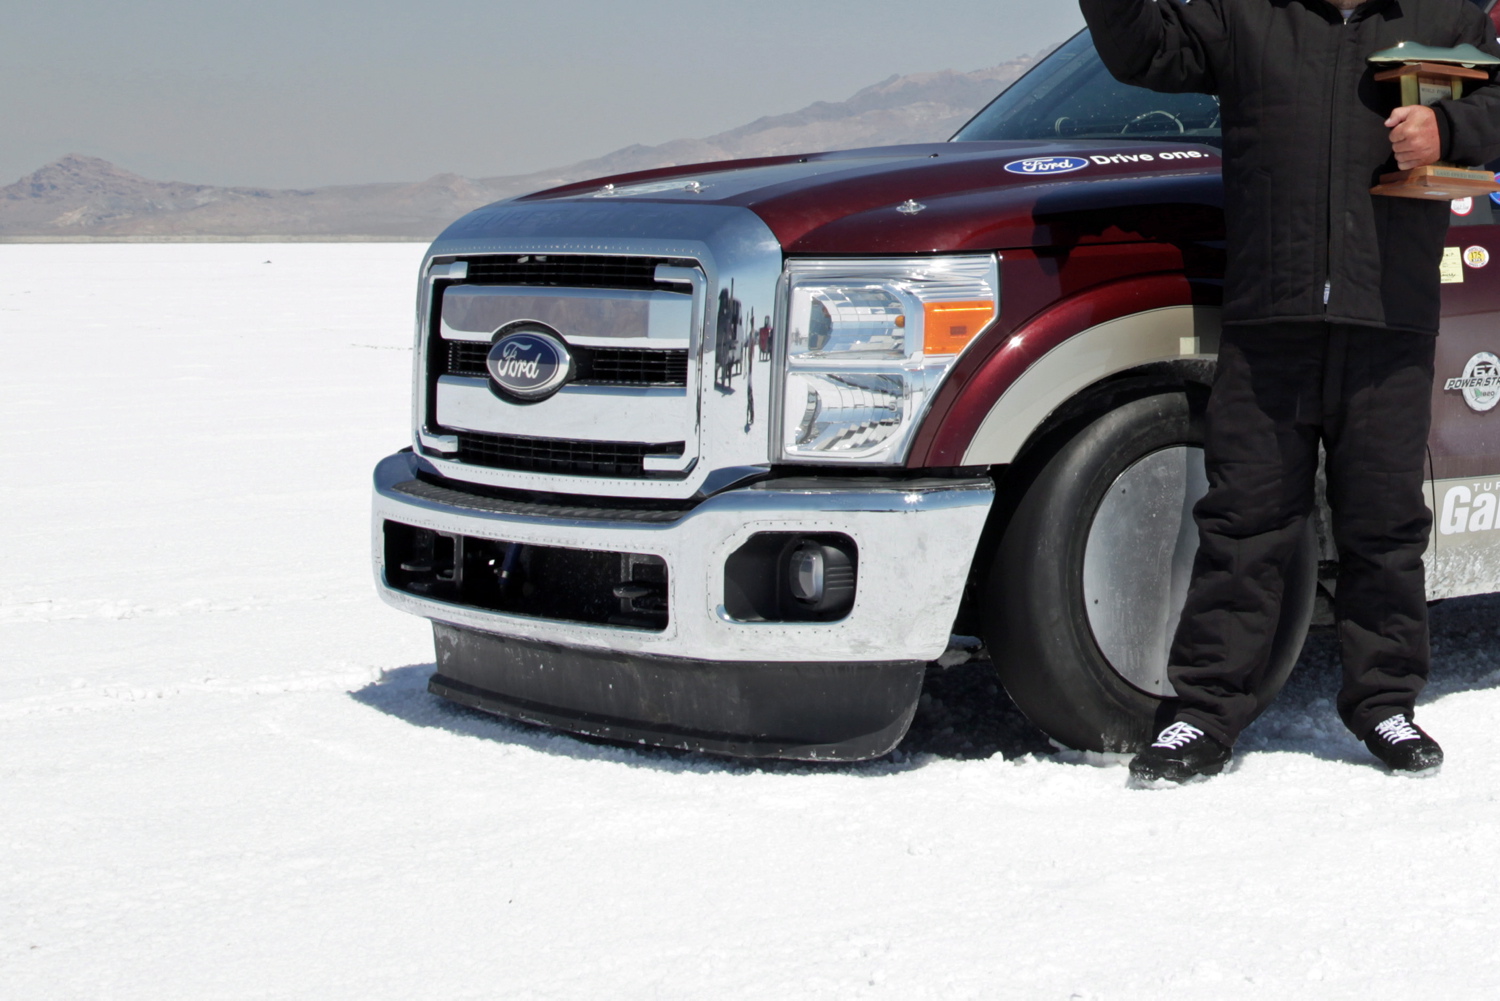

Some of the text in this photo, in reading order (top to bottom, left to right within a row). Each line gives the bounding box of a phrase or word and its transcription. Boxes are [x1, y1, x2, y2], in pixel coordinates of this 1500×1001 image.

[1022, 150, 1210, 172] Ford Drive one.
[498, 341, 541, 379] Ford
[1447, 379, 1483, 389] POWER
